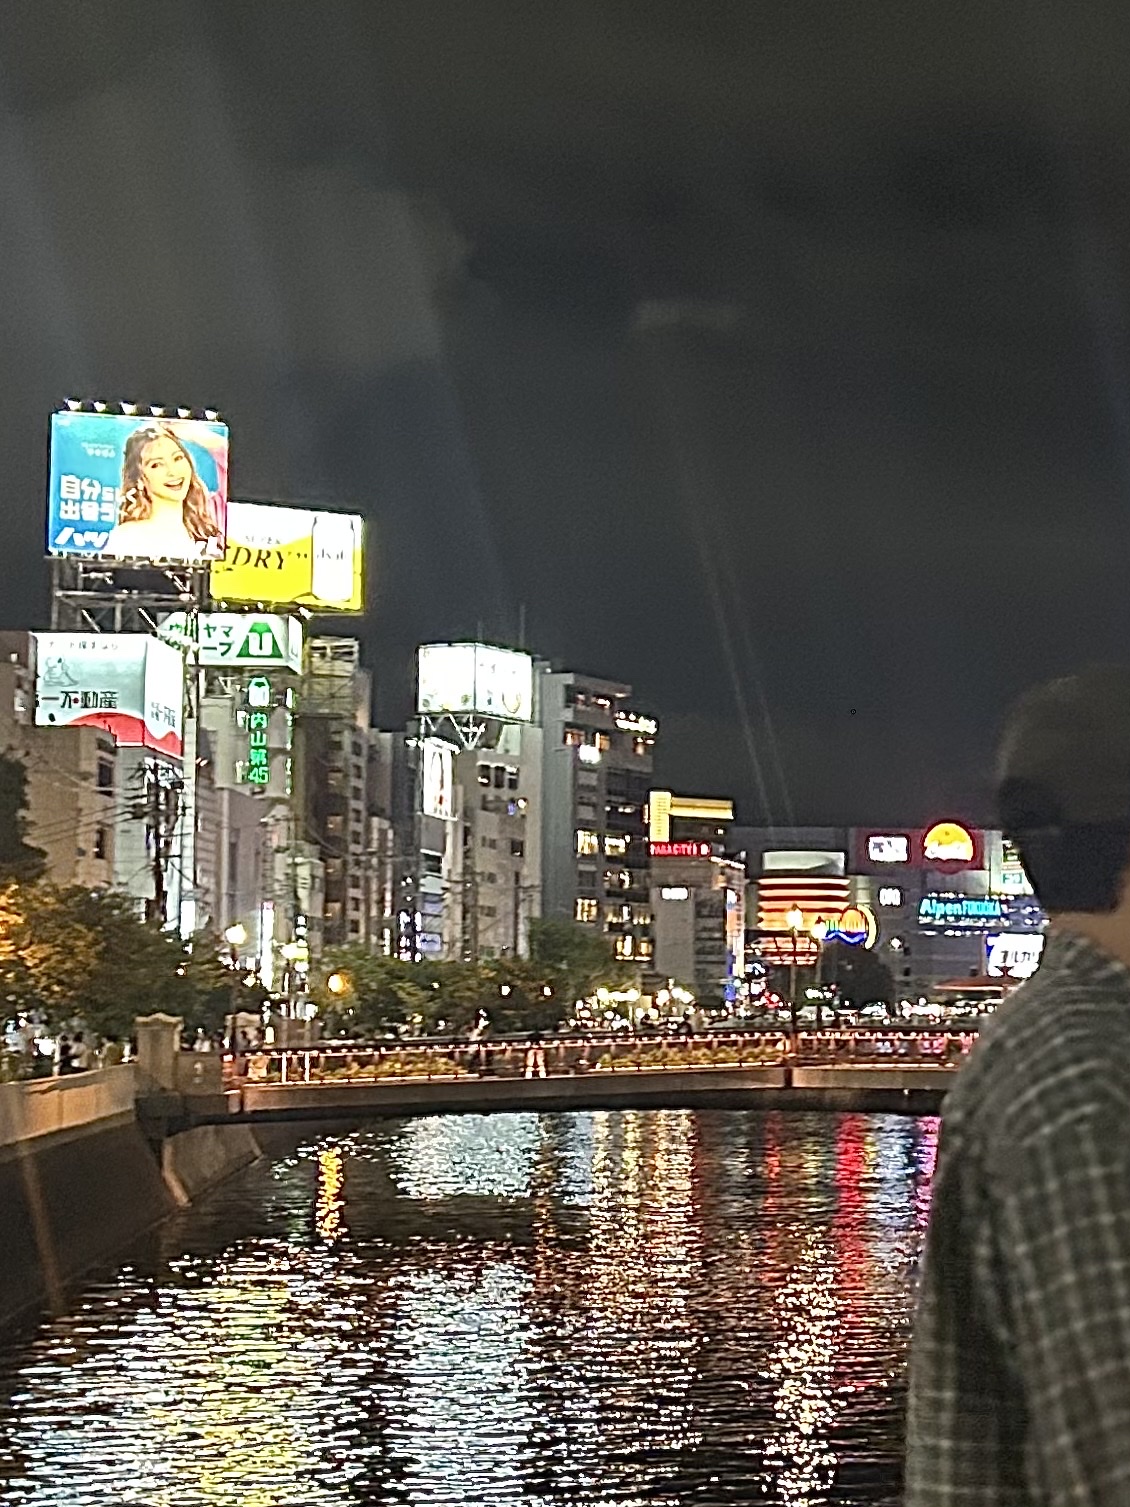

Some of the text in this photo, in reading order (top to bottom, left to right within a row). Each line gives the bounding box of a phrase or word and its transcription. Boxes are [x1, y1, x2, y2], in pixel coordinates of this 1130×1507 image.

[35, 690, 118, 709] 一不動産
[919, 898, 1001, 917] Alpen FUKUOKA
